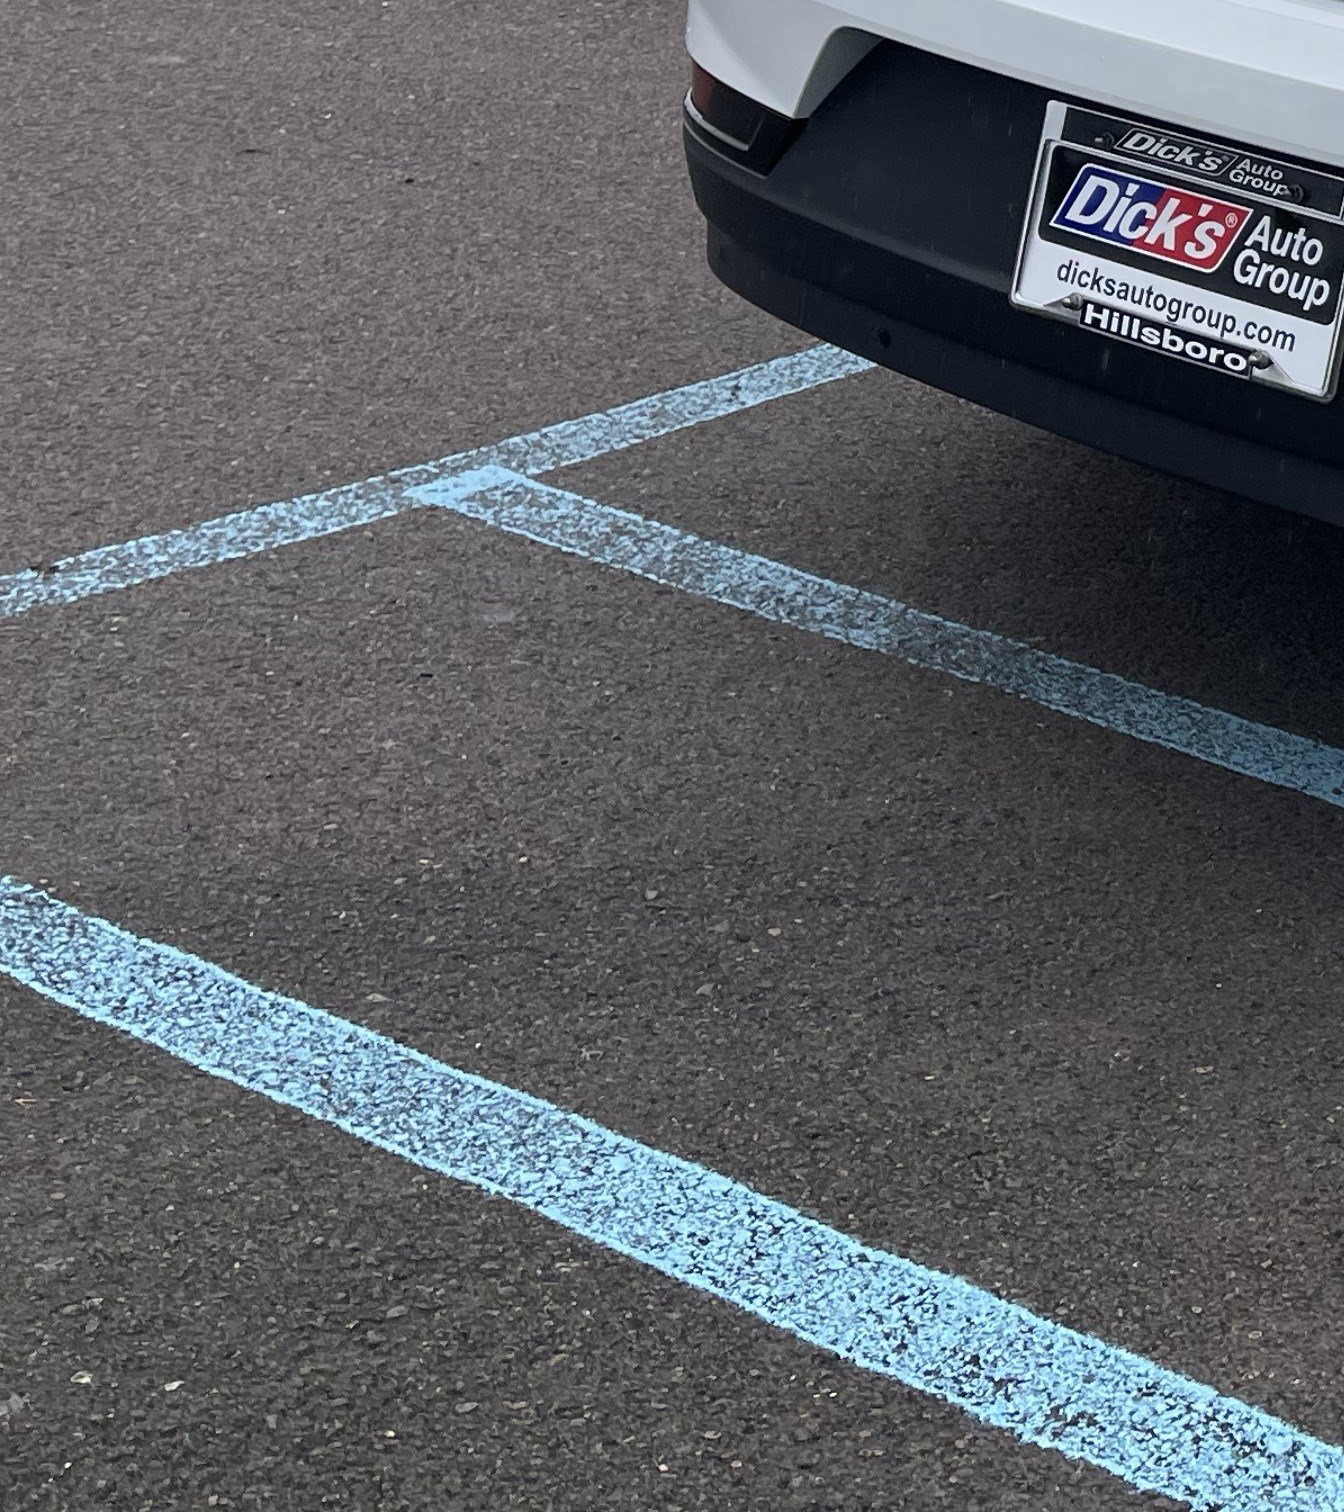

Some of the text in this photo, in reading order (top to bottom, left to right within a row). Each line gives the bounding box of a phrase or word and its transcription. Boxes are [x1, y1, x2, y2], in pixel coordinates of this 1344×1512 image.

[1228, 169, 1290, 197] Group
[1235, 158, 1284, 181] Auto
[1244, 215, 1325, 267] Auto
[1056, 259, 1296, 353] dicksautogroup.com
[1232, 248, 1332, 311] Group
[1083, 303, 1248, 372] Hillsboro
